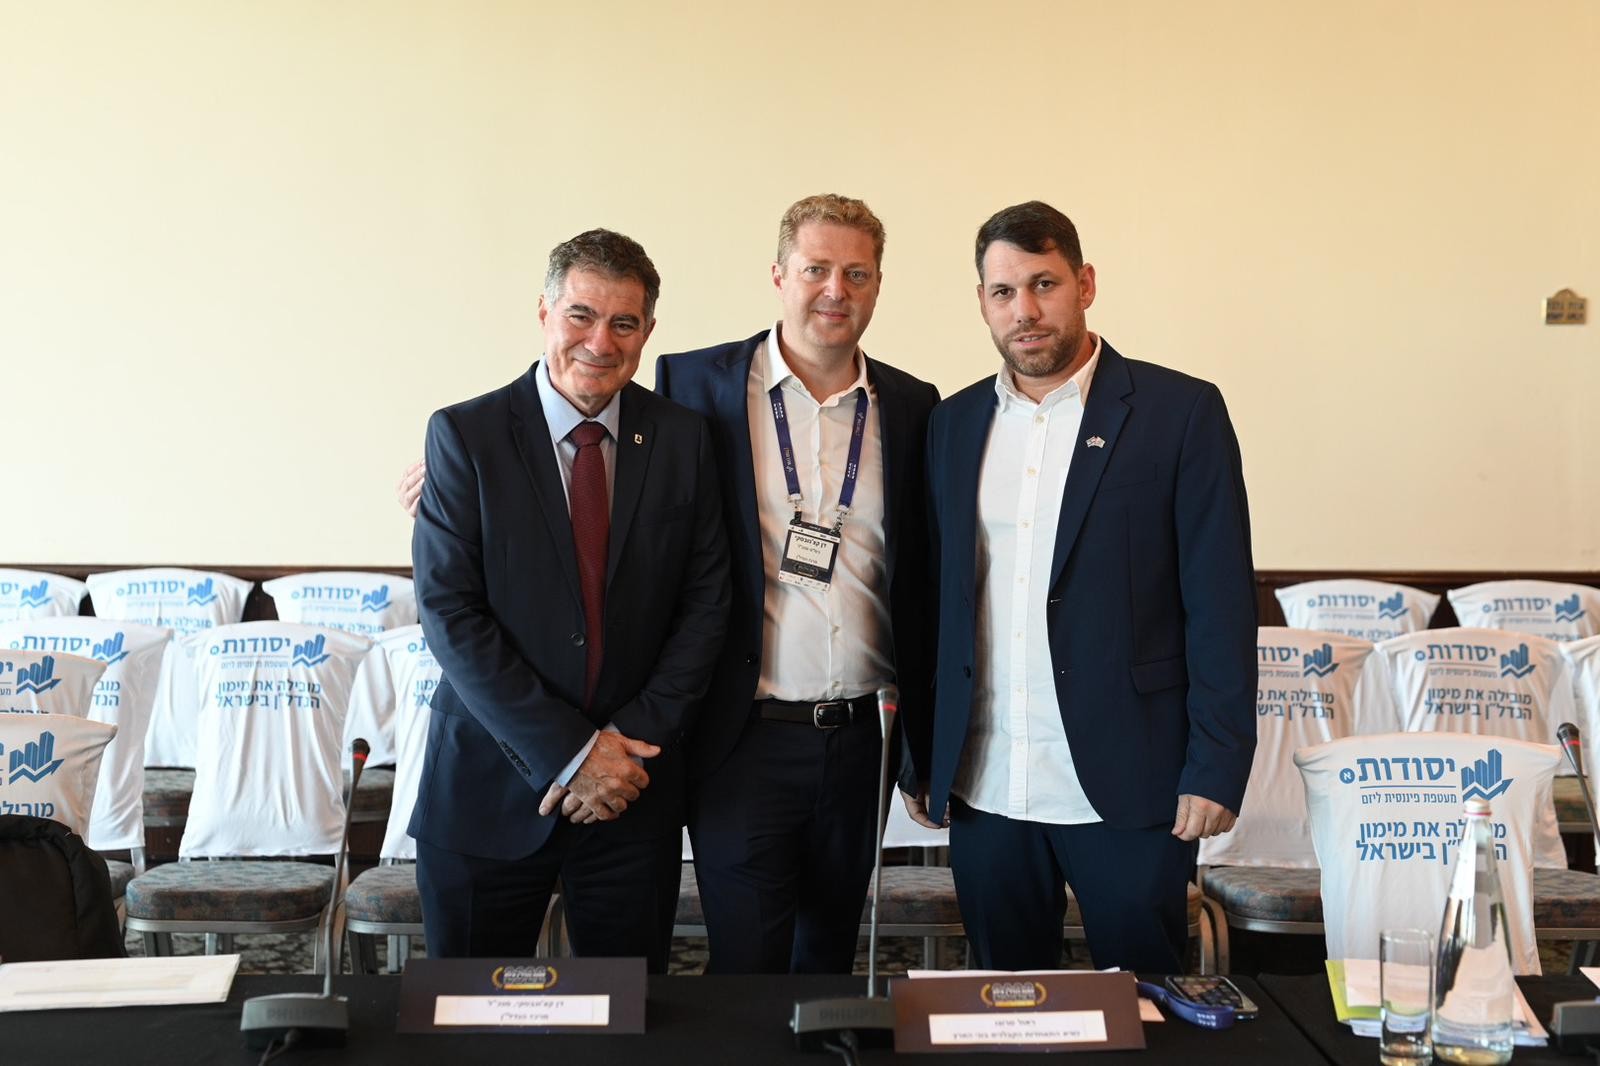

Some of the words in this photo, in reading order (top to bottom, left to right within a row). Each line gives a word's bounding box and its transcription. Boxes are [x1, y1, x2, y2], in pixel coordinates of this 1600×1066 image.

[22, 635, 91, 652] יסודות
[222, 637, 291, 653] יסודות
[1258, 646, 1299, 662] יסוד
[1427, 644, 1497, 661] יסודות
[254, 680, 273, 691] את
[277, 679, 321, 694] מובילה
[1268, 689, 1287, 700] את
[1291, 688, 1335, 704] מובילה
[1428, 688, 1461, 702] מימון
[1465, 689, 1484, 700] את
[1488, 689, 1533, 705] מובילה
[1425, 700, 1481, 715] בישראל
[1356, 757, 1456, 782] יסודות
[1361, 792, 1382, 804] ליזם
[1385, 792, 1421, 803] פיננסית
[1424, 793, 1457, 804] מעטפת
[1360, 821, 1407, 843] מימון
[1412, 821, 1440, 838] את
[1356, 840, 1437, 861] בישראל
